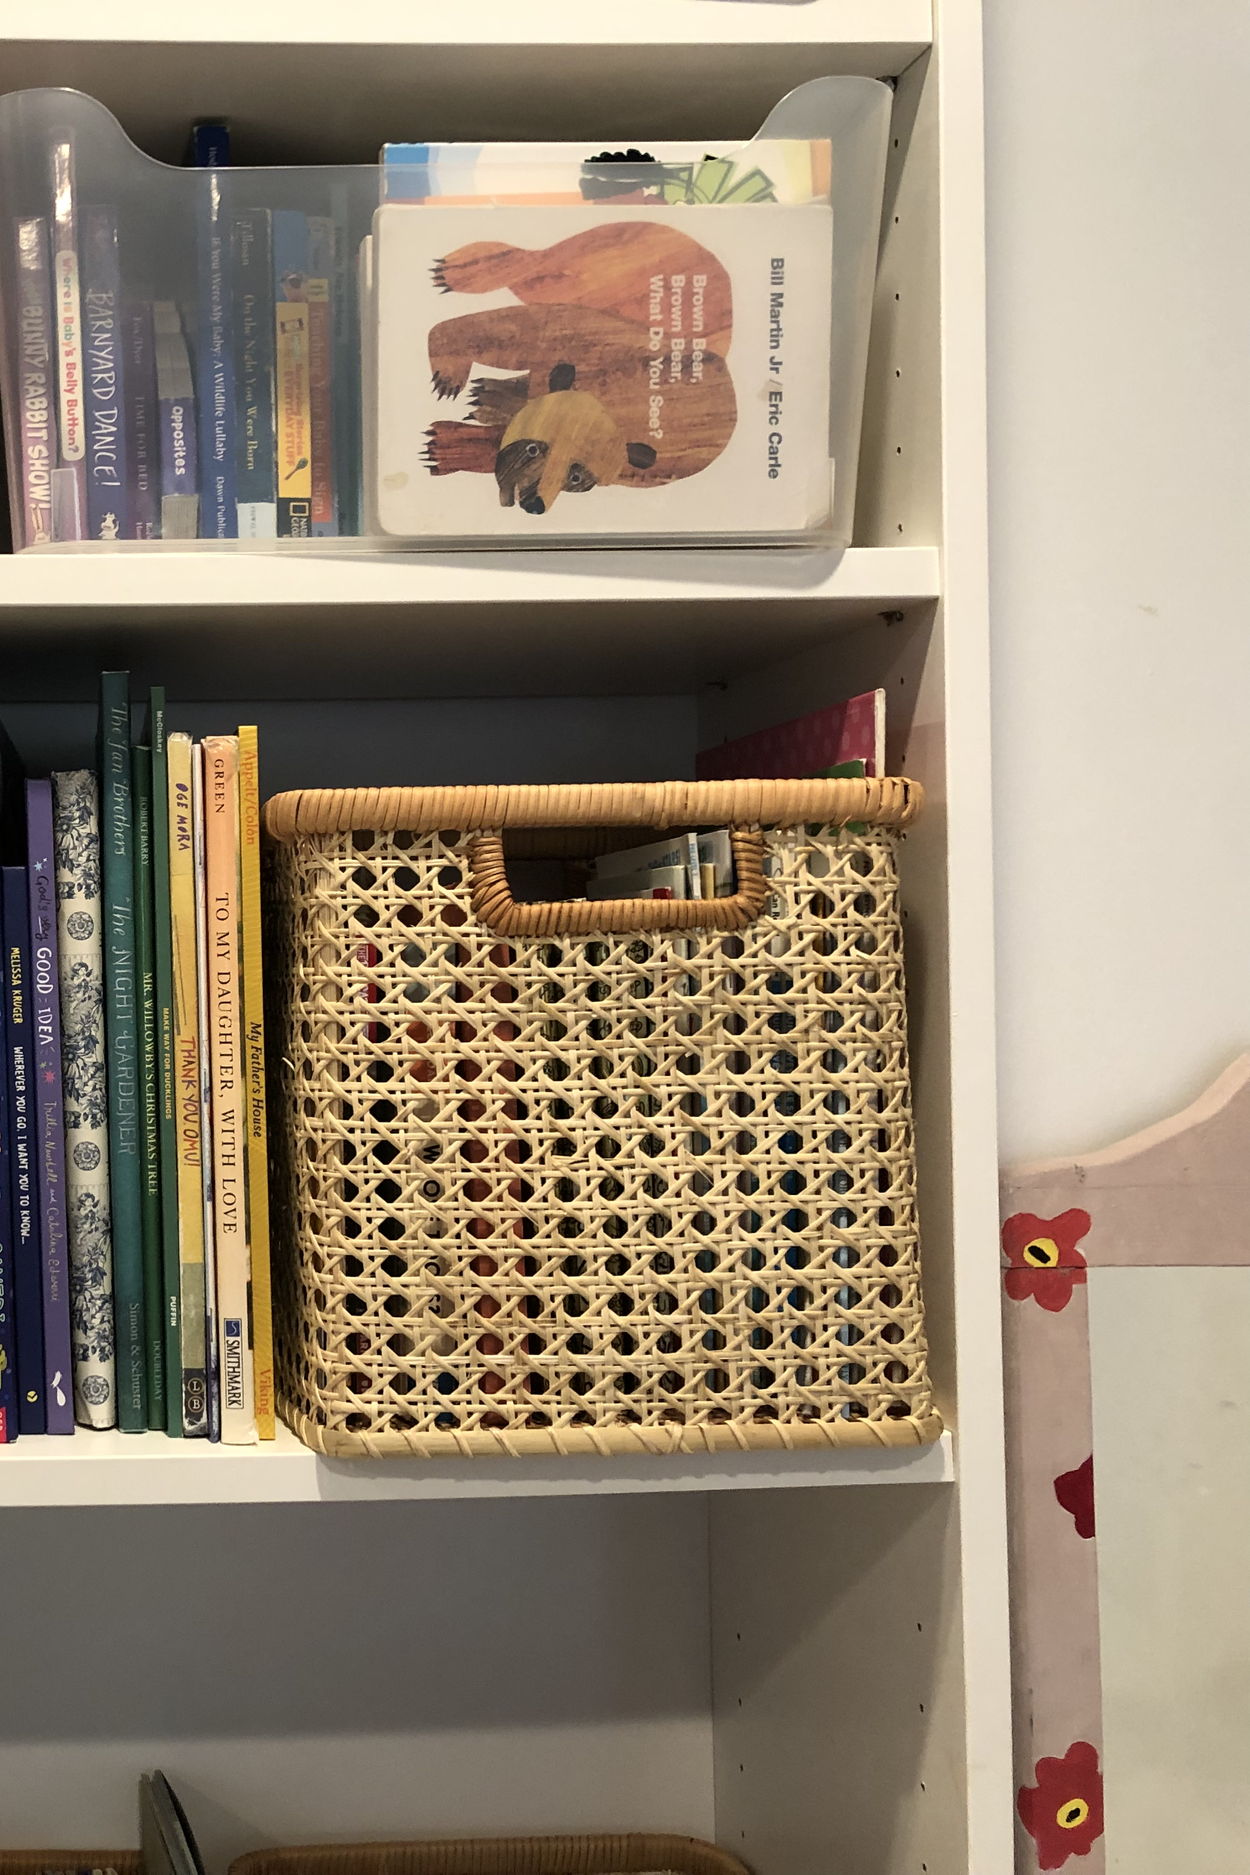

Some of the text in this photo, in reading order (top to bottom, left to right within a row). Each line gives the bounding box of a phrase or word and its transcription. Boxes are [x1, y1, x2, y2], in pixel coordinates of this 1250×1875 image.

[62, 258, 74, 299] Where
[770, 257, 784, 286] Bill
[62, 317, 77, 357] Baby's
[667, 274, 686, 384] Brown Bear,
[689, 274, 707, 384] Brown Bear,
[769, 292, 784, 350] Martin
[63, 362, 77, 394] Belly
[648, 274, 664, 439] What Do You See?
[769, 354, 783, 375] Jr
[21, 306, 51, 509] BUNNY RABBIT SHOW!
[85, 289, 121, 486] BARNYARD DANCE!
[768, 390, 783, 426] Eric
[66, 399, 80, 453] Button?
[212, 373, 227, 462] Wildlife Lullaby
[246, 406, 257, 470] Were Born
[767, 432, 783, 479] Carle
[155, 710, 164, 753] McCloskey
[214, 758, 225, 814] GREEN
[175, 782, 191, 852] OGE MORA
[10, 947, 23, 1024] MELISSA KRUGER
[36, 947, 54, 1045] GOOD IDEA
[111, 898, 137, 1155] The NIGHT GARDENER
[13, 1046, 26, 1091] WHEREVER
[142, 972, 158, 1196] MR. WILLOWBY'S CHRISTMAS TREE
[179, 1035, 199, 1089] THANK
[215, 892, 237, 1234] TO MY DAUGHTER, WITH LOVE
[246, 1022, 265, 1138] My Father's House
[15, 1095, 27, 1113] YOU
[164, 1071, 173, 1120] DUCKLINGS
[17, 1143, 29, 1170] WANT
[183, 1128, 201, 1167] OMU!
[18, 1173, 29, 1191] YOU
[19, 1194, 30, 1207] TO
[19, 1210, 31, 1244] KNOW...
[153, 1340, 163, 1401] DOUBLEDAY
[226, 1339, 242, 1407] SMITHMARK
[258, 1368, 272, 1415] Viking
